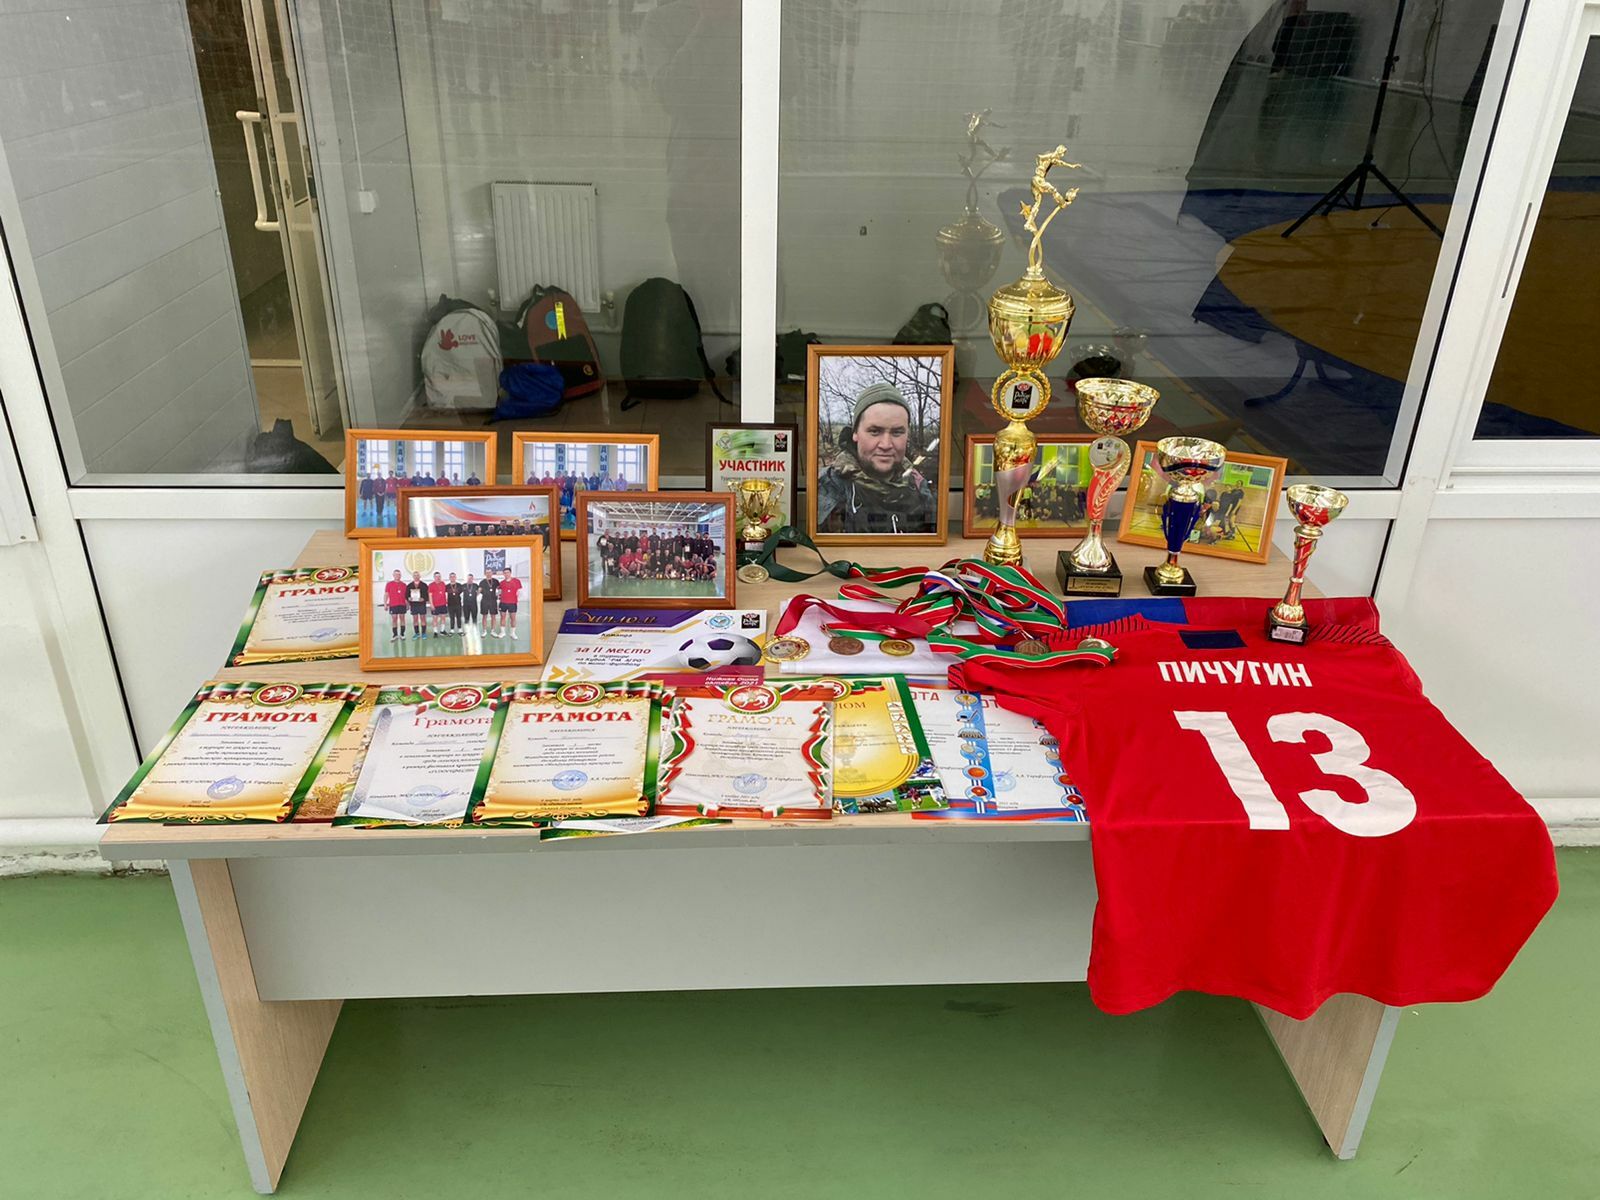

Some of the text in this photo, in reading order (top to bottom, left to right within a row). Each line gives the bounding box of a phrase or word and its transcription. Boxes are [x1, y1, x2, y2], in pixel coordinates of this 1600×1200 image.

[719, 460, 785, 472] УЧАСТНИК
[279, 586, 360, 598] ГРАМОТ
[604, 647, 651, 655] место
[1157, 661, 1313, 688] ПИЧУГИН
[204, 712, 319, 723] ГРАМОТА
[413, 717, 494, 729] Грамота
[521, 711, 633, 723] ГРАМОТА
[707, 714, 797, 726] ГРАМОТА
[1173, 710, 1418, 838] 13
